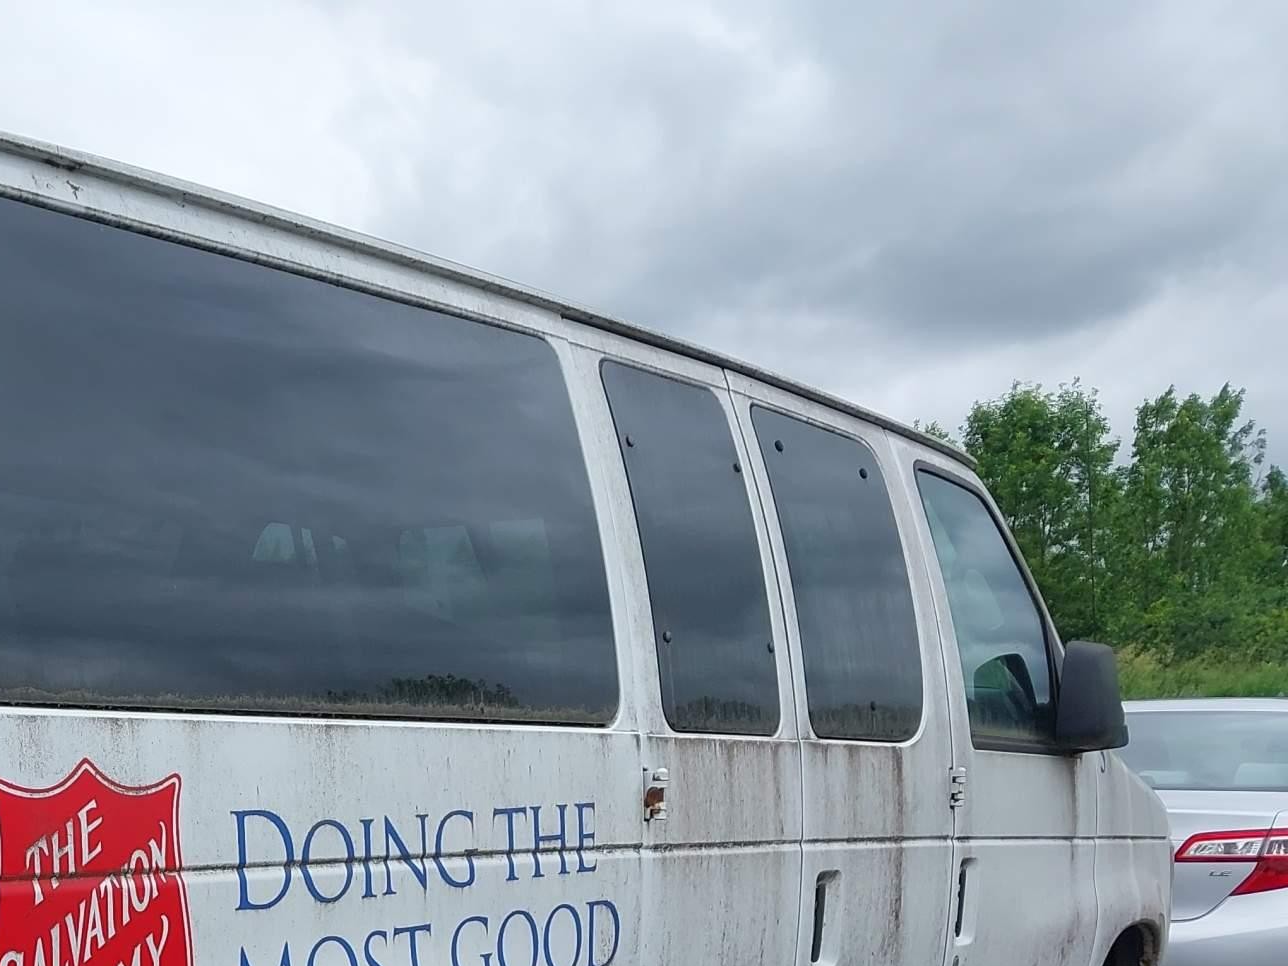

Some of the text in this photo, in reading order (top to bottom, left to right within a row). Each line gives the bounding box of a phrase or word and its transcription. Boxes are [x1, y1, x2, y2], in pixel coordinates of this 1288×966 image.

[26, 799, 103, 906] THE
[230, 802, 598, 912] DOING THE
